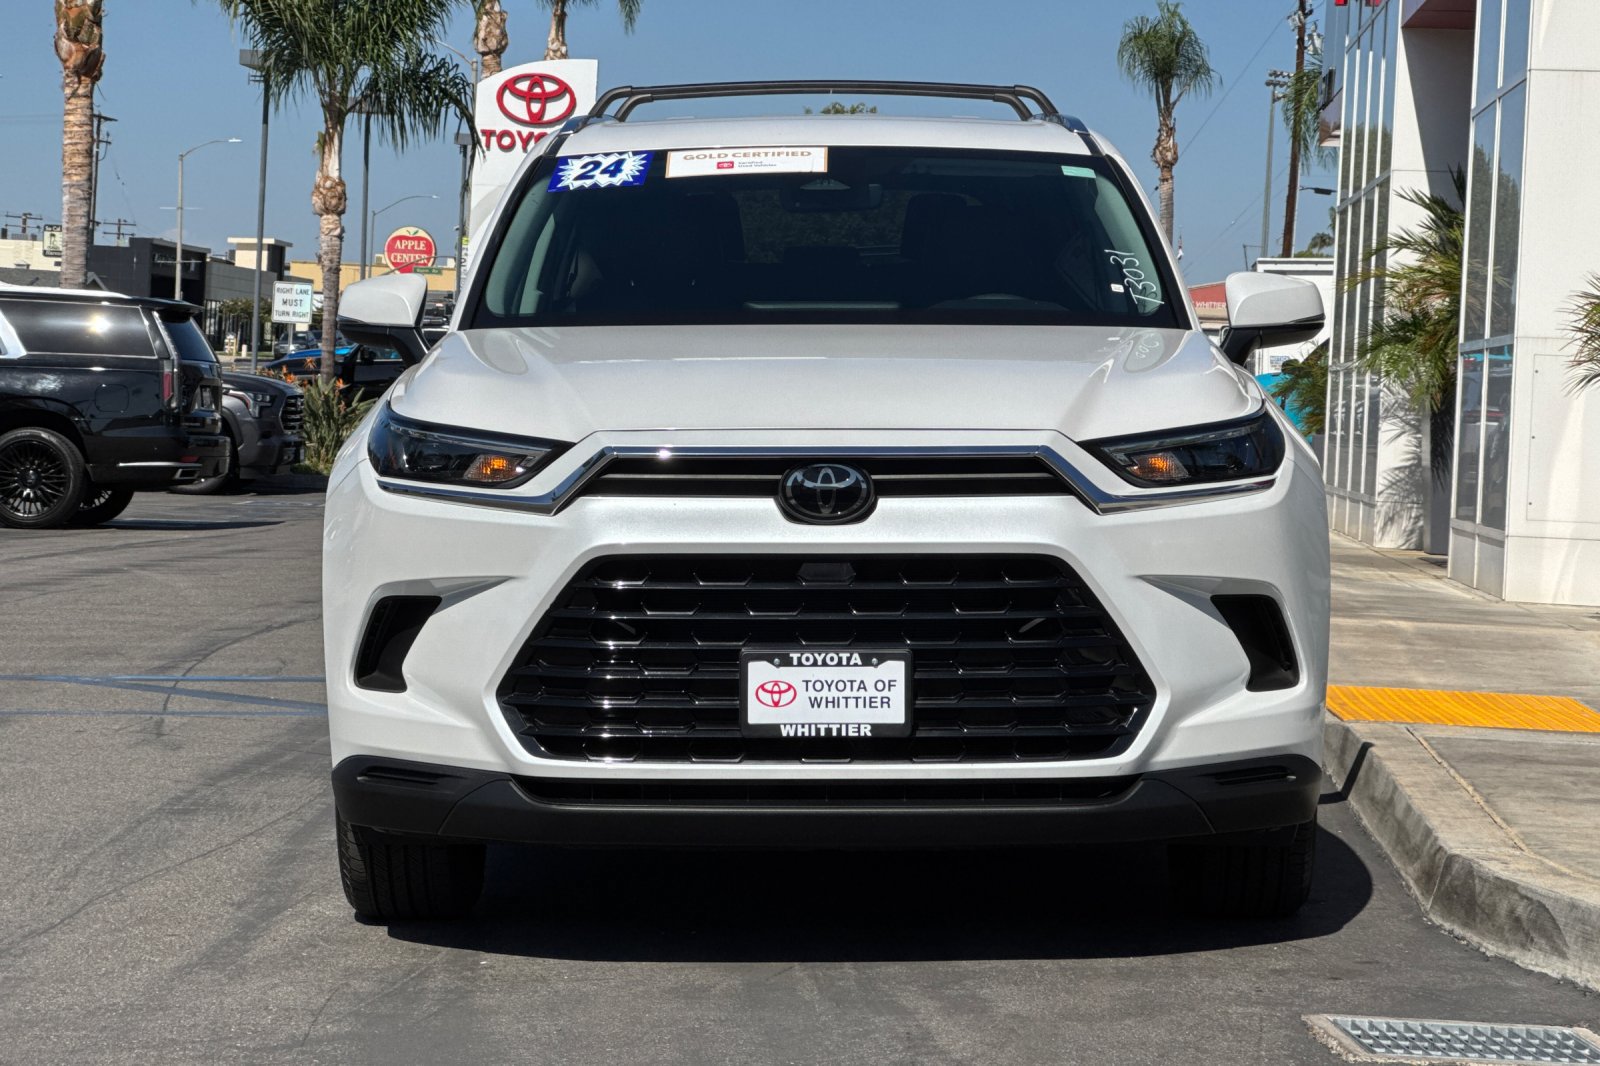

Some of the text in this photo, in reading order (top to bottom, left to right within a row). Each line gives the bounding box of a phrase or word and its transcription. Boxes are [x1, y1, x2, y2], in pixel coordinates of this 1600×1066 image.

[683, 150, 812, 160] GOLD CERTIFIED
[573, 158, 626, 181] 24
[395, 239, 427, 251] APPLE
[390, 252, 428, 264] CENTER
[282, 298, 303, 307] MUST
[789, 653, 862, 666] TOYOTA
[802, 679, 897, 693] TOYOTA OF
[808, 696, 891, 709] WHITTIER
[780, 724, 872, 737] WHITTIER
